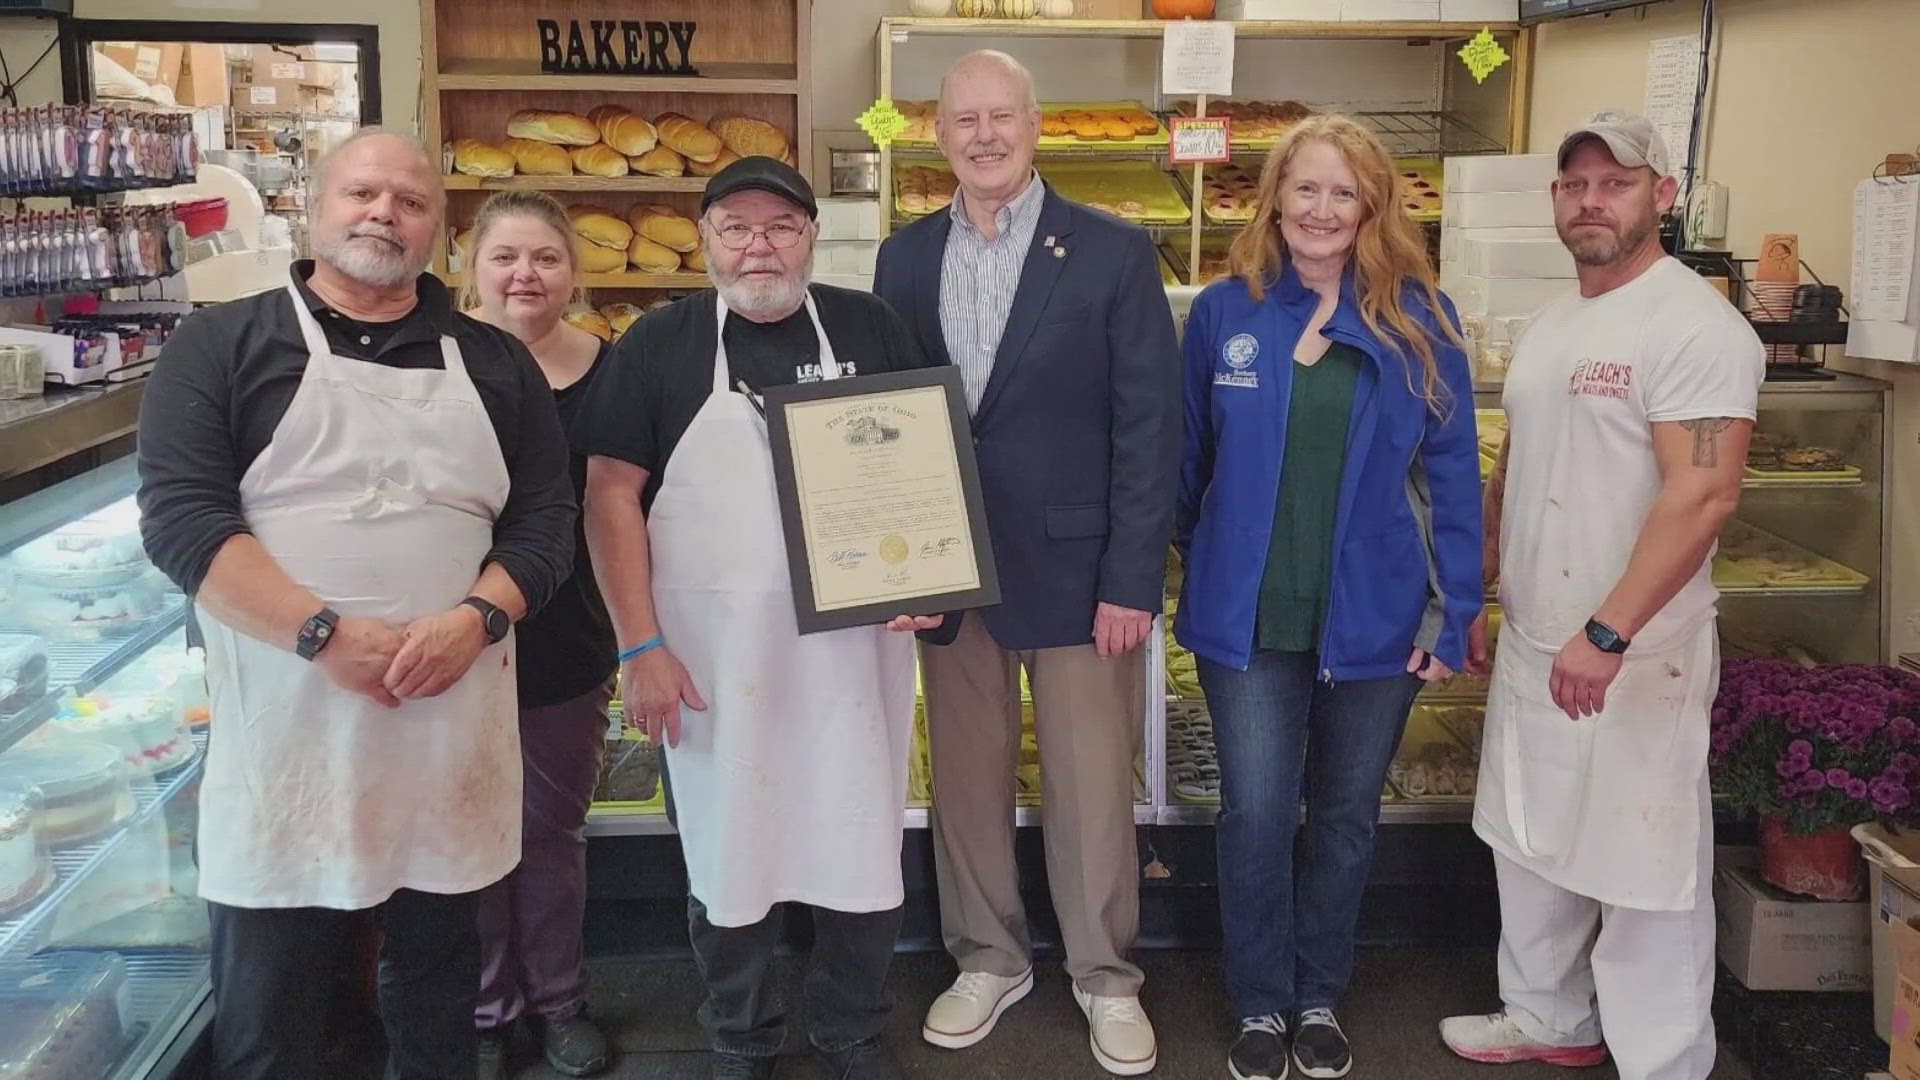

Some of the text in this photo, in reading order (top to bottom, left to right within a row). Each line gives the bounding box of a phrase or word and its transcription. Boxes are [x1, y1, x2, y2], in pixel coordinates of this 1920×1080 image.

[537, 19, 698, 74] BAKERY
[1175, 120, 1224, 129] SPECIAL
[796, 361, 857, 379] LEAH'S
[1585, 361, 1632, 386] LEACH'S
[845, 405, 873, 417] STATE
[893, 406, 918, 420] OHIO
